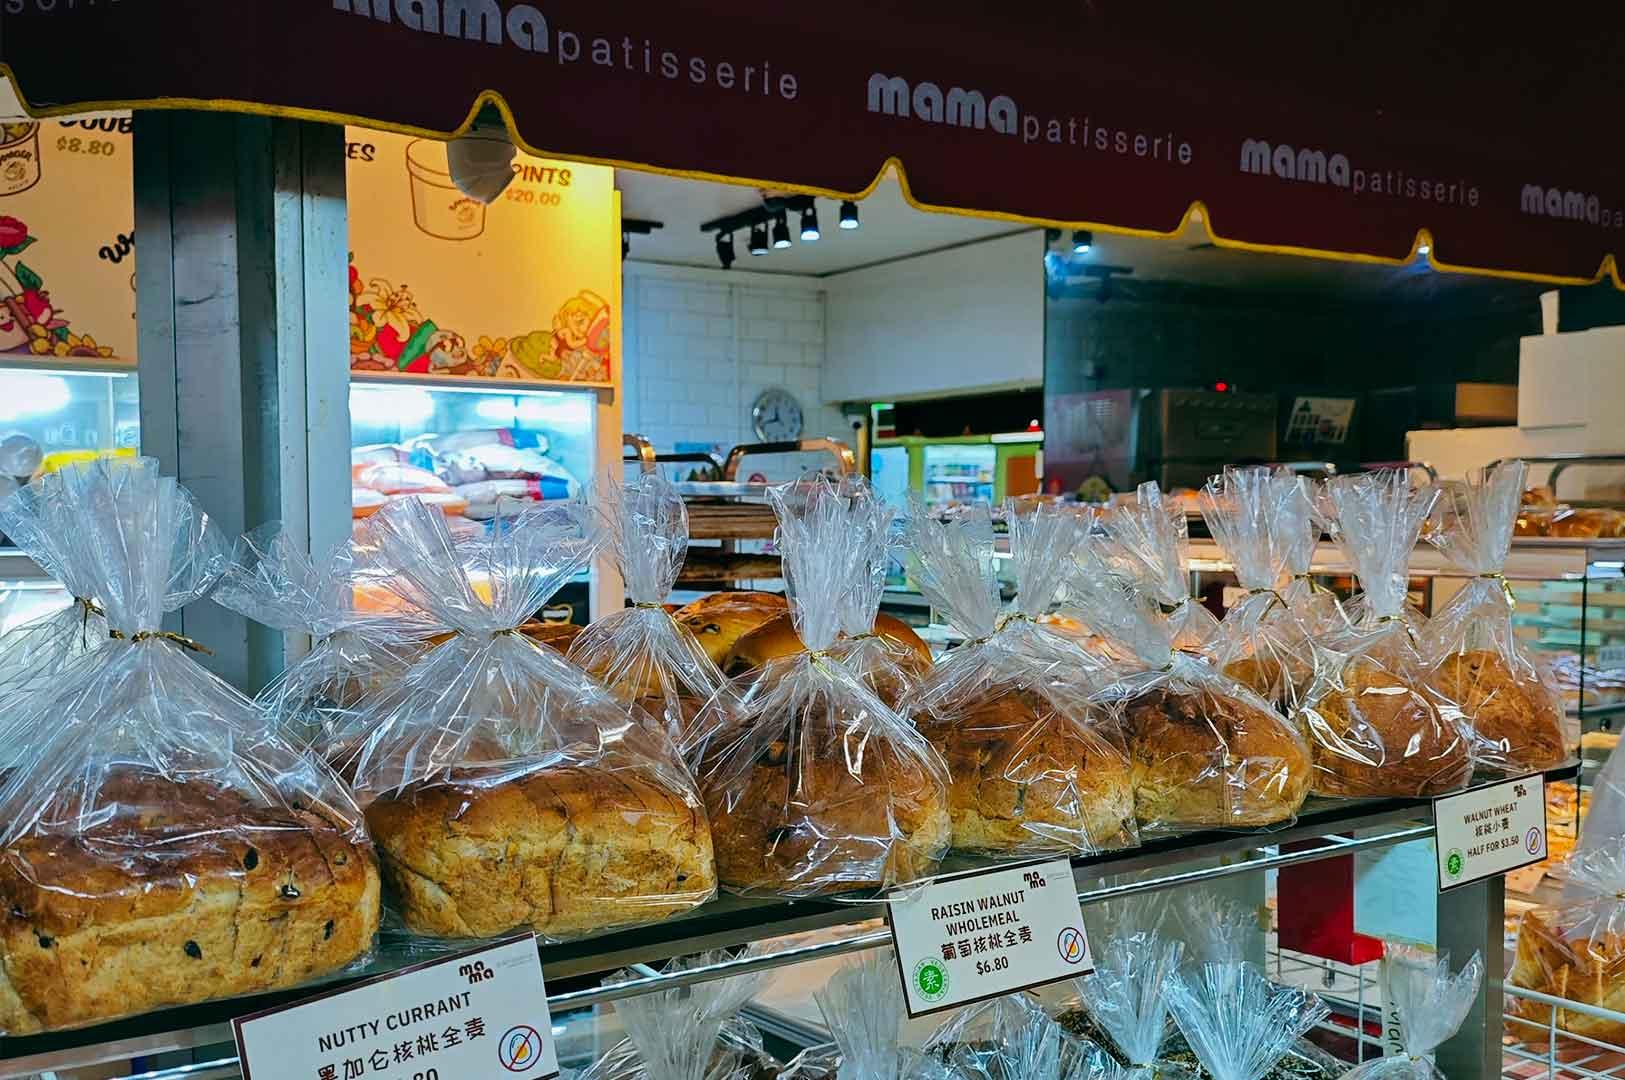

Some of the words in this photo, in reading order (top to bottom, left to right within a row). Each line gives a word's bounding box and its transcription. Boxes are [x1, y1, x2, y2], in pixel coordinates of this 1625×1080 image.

[558, 30, 798, 100] patisserie
[867, 72, 1018, 135] mama
[1023, 114, 1192, 165] patisserie
[56, 136, 115, 156] $8.80
[1240, 138, 1349, 187] mama
[1353, 169, 1480, 207] patisserie
[1520, 183, 1600, 224] mama
[1464, 808, 1493, 825] WALNUT
[1494, 802, 1518, 816] WHEAT
[1467, 845, 1485, 858] HALF
[1486, 841, 1499, 852] FOR
[1501, 835, 1519, 848] $3.50
[1023, 871, 1040, 882] ma
[1029, 878, 1046, 889] ma
[931, 900, 975, 920] RAISIN
[977, 890, 1026, 911] WALNUT
[946, 910, 1020, 937] WHOLEMEAL
[941, 926, 1033, 960] 葡萄核桃全麦
[459, 960, 485, 976] ma
[469, 968, 494, 984] ma
[976, 956, 1009, 976] $6.80
[318, 1019, 380, 1052] NUTTY
[386, 992, 471, 1031] CURRANT
